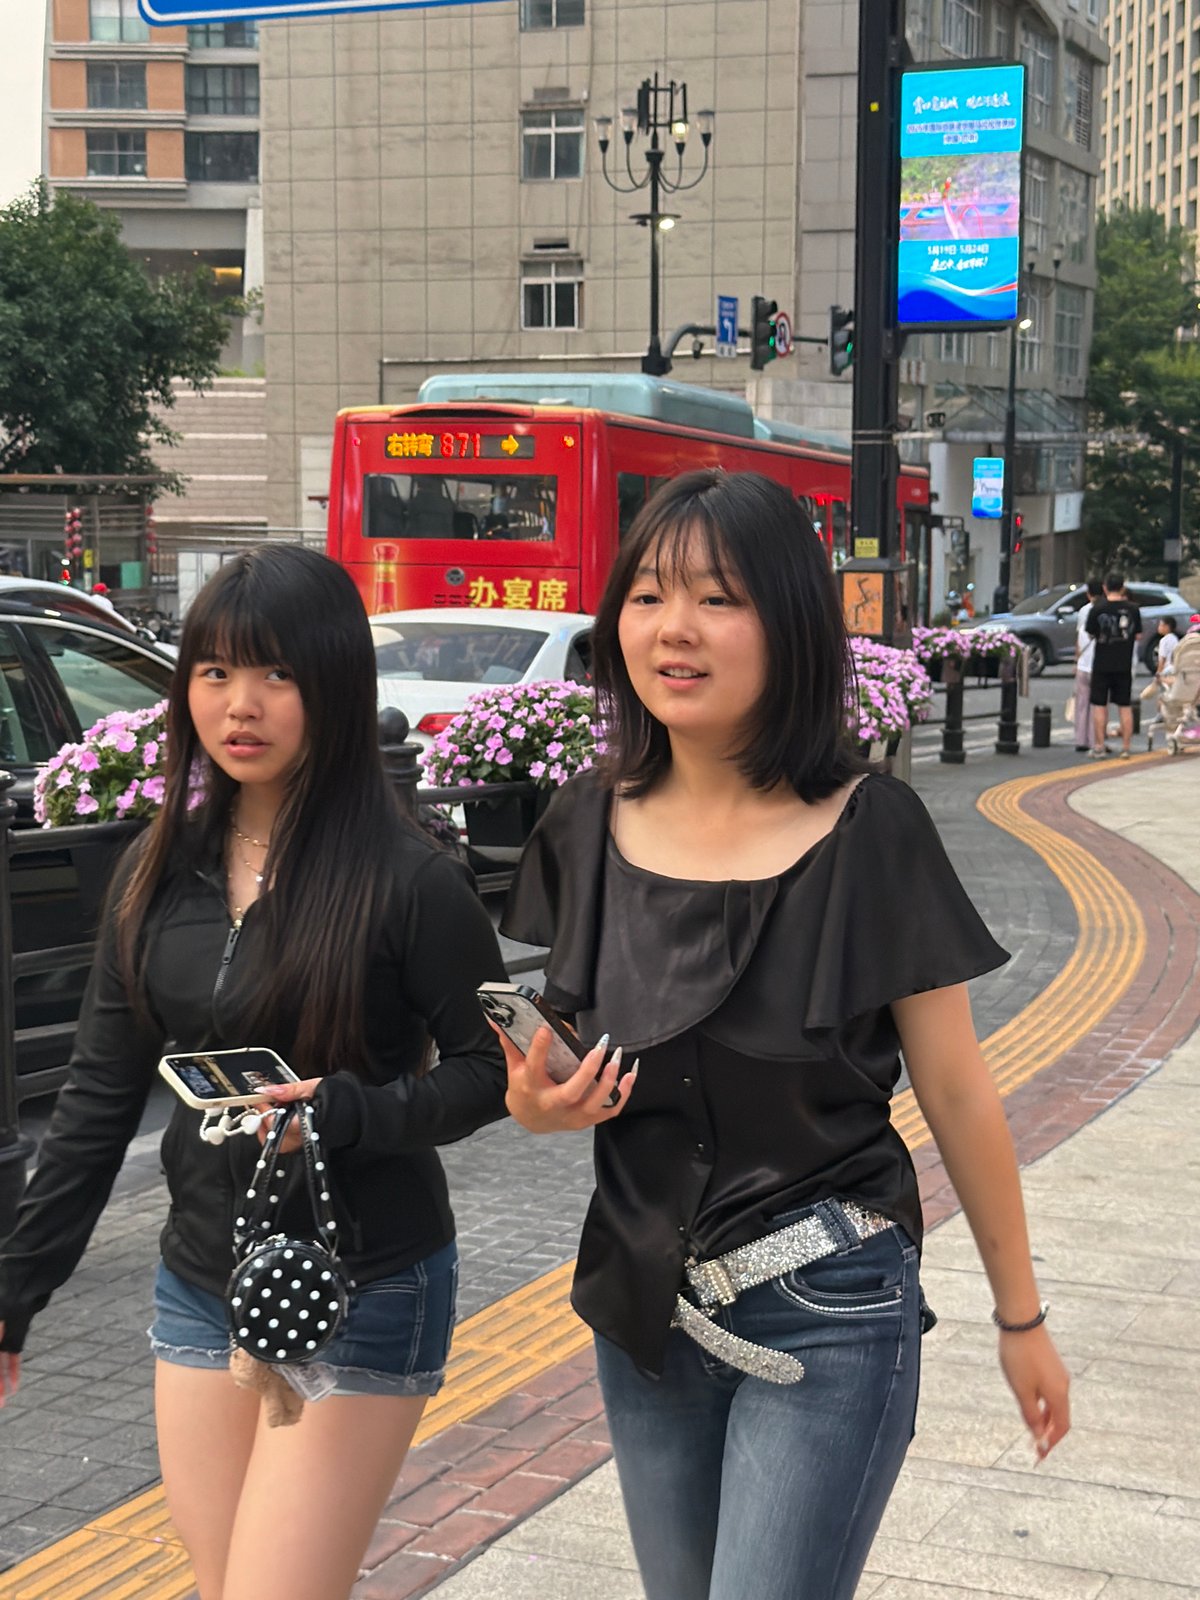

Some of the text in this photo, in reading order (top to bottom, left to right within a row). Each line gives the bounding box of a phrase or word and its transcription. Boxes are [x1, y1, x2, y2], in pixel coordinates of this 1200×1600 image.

[387, 432, 481, 458] 右转弯 871
[469, 576, 568, 611] 办宴席
